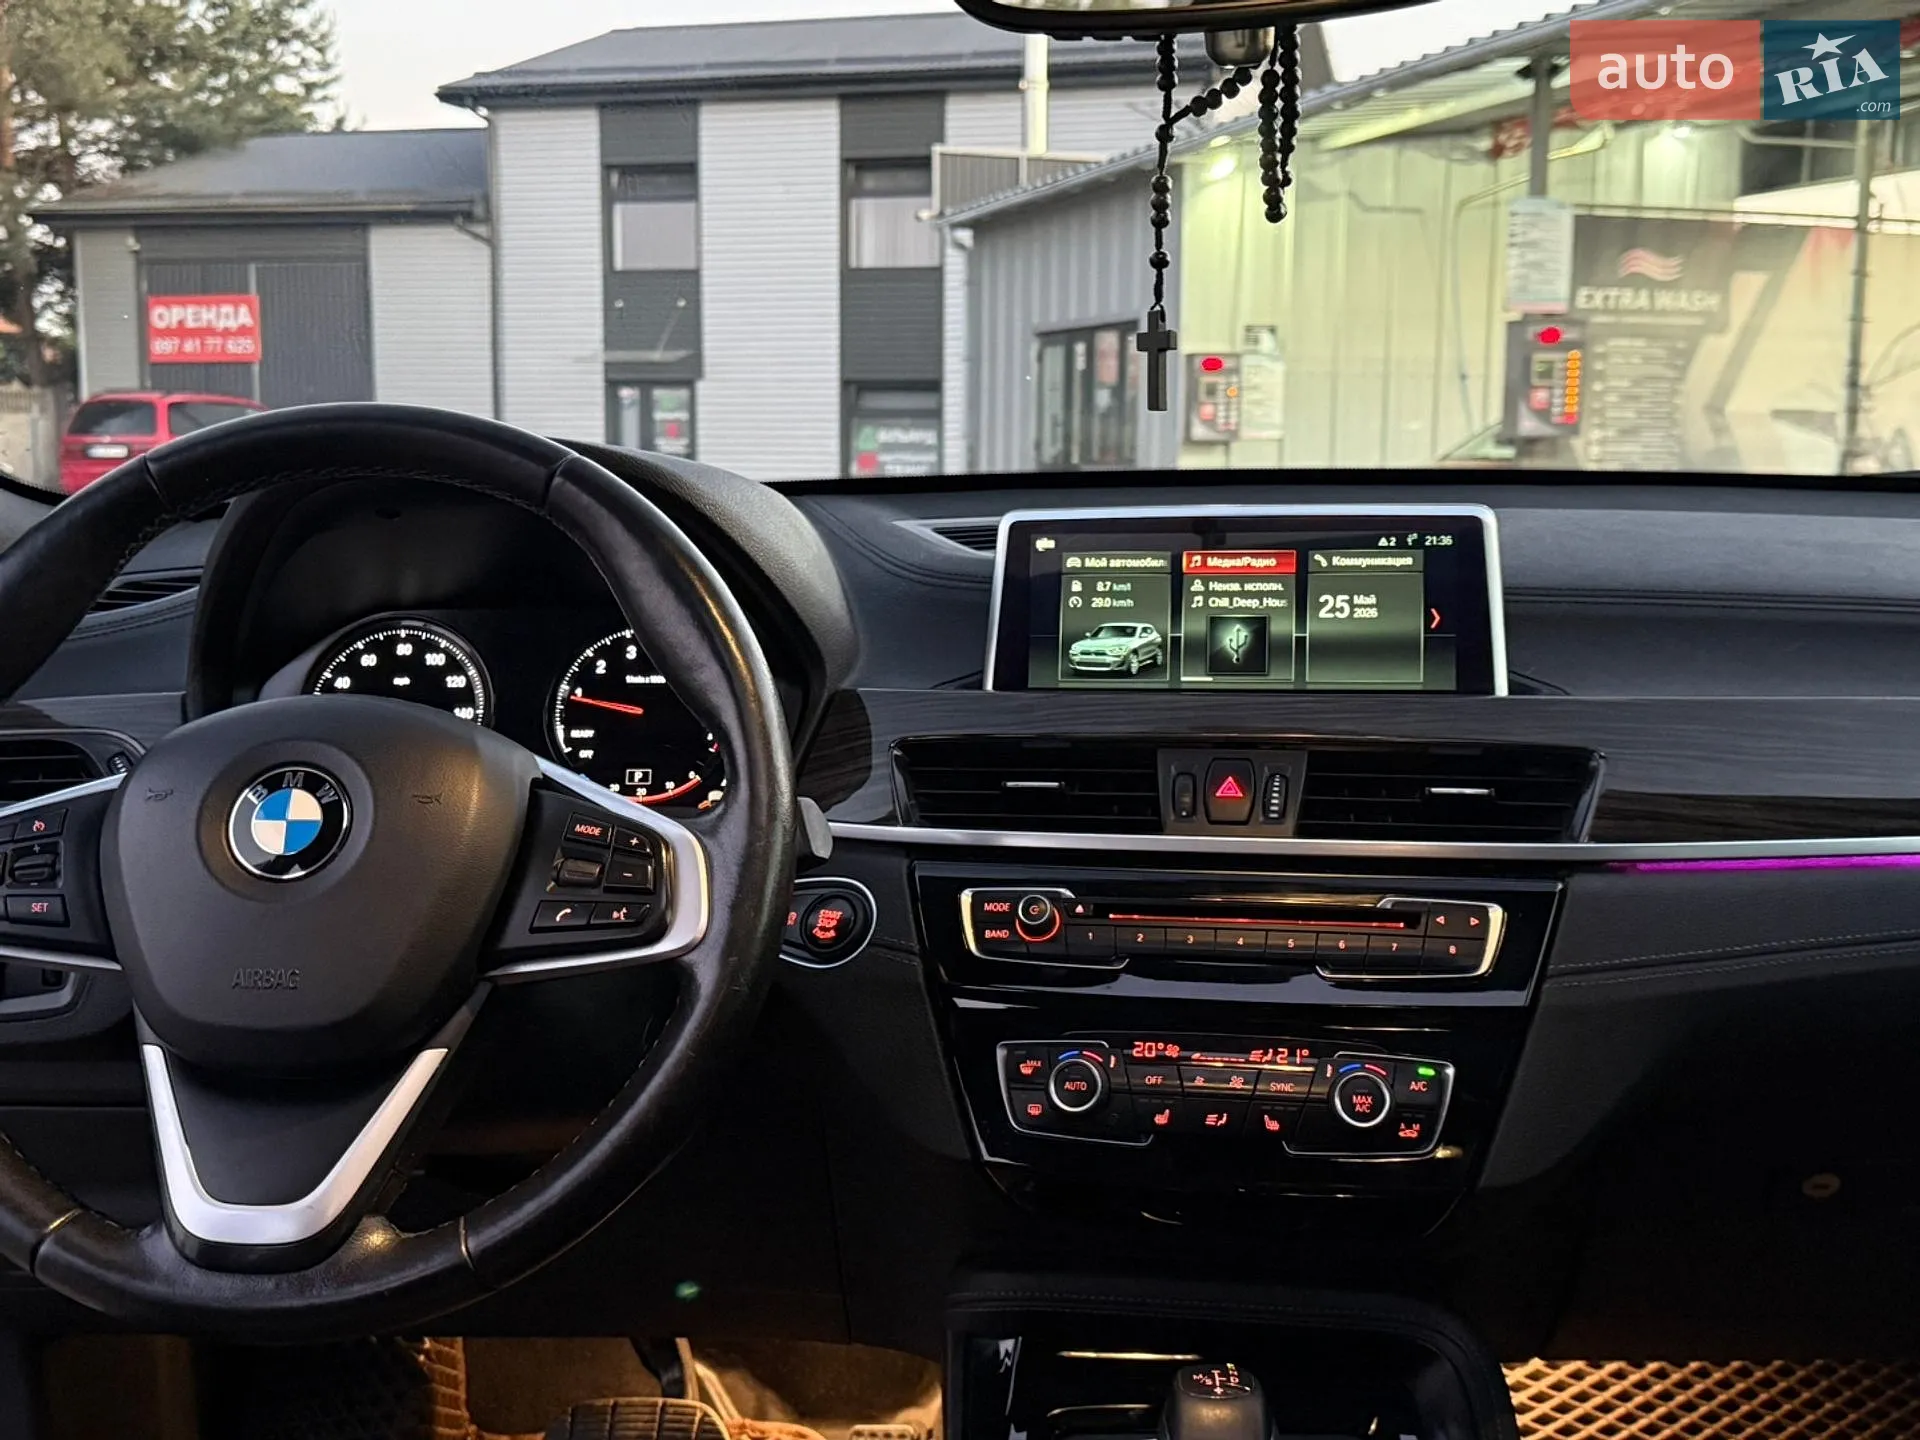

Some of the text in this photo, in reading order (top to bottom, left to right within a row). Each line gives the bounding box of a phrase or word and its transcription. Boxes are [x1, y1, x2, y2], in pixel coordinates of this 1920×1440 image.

[1575, 286, 1722, 312] EXTRA WASH
[150, 303, 254, 332] ОРЕНДА
[1084, 557, 1108, 568] Мой
[1206, 556, 1277, 568] Медиа/Радио
[1332, 556, 1414, 568] Коммуникация
[1096, 581, 1112, 592] 8.7
[1244, 582, 1285, 592] исполн.
[1353, 594, 1377, 605] Май
[1319, 594, 1350, 619] 25
[1353, 607, 1378, 619] 2026
[396, 643, 413, 656] 80
[625, 645, 637, 660] 3
[360, 654, 377, 667] 60
[424, 653, 446, 666] 100
[595, 660, 606, 674] 2
[334, 676, 351, 689] 40
[445, 675, 466, 688] 120
[634, 771, 643, 783] P
[247, 772, 338, 805] BMW
[575, 824, 602, 836] MODE
[31, 902, 48, 913] SET
[983, 902, 1011, 912] MODE
[984, 929, 1009, 939] BAND
[1087, 932, 1094, 941] 1
[1135, 933, 1144, 943] 2
[1186, 934, 1194, 944] 3
[1237, 937, 1244, 945] 4
[1287, 938, 1295, 948] 5
[1338, 940, 1345, 949] 6
[1391, 943, 1398, 951] 7
[232, 968, 300, 989] AIRBAG
[1064, 1080, 1087, 1091] AUTO
[1145, 1075, 1164, 1085] OFF
[1270, 1082, 1295, 1092] SYNC
[1409, 1081, 1427, 1091] A/C
[1352, 1095, 1372, 1104] MAX
[1355, 1103, 1371, 1113] A/C
